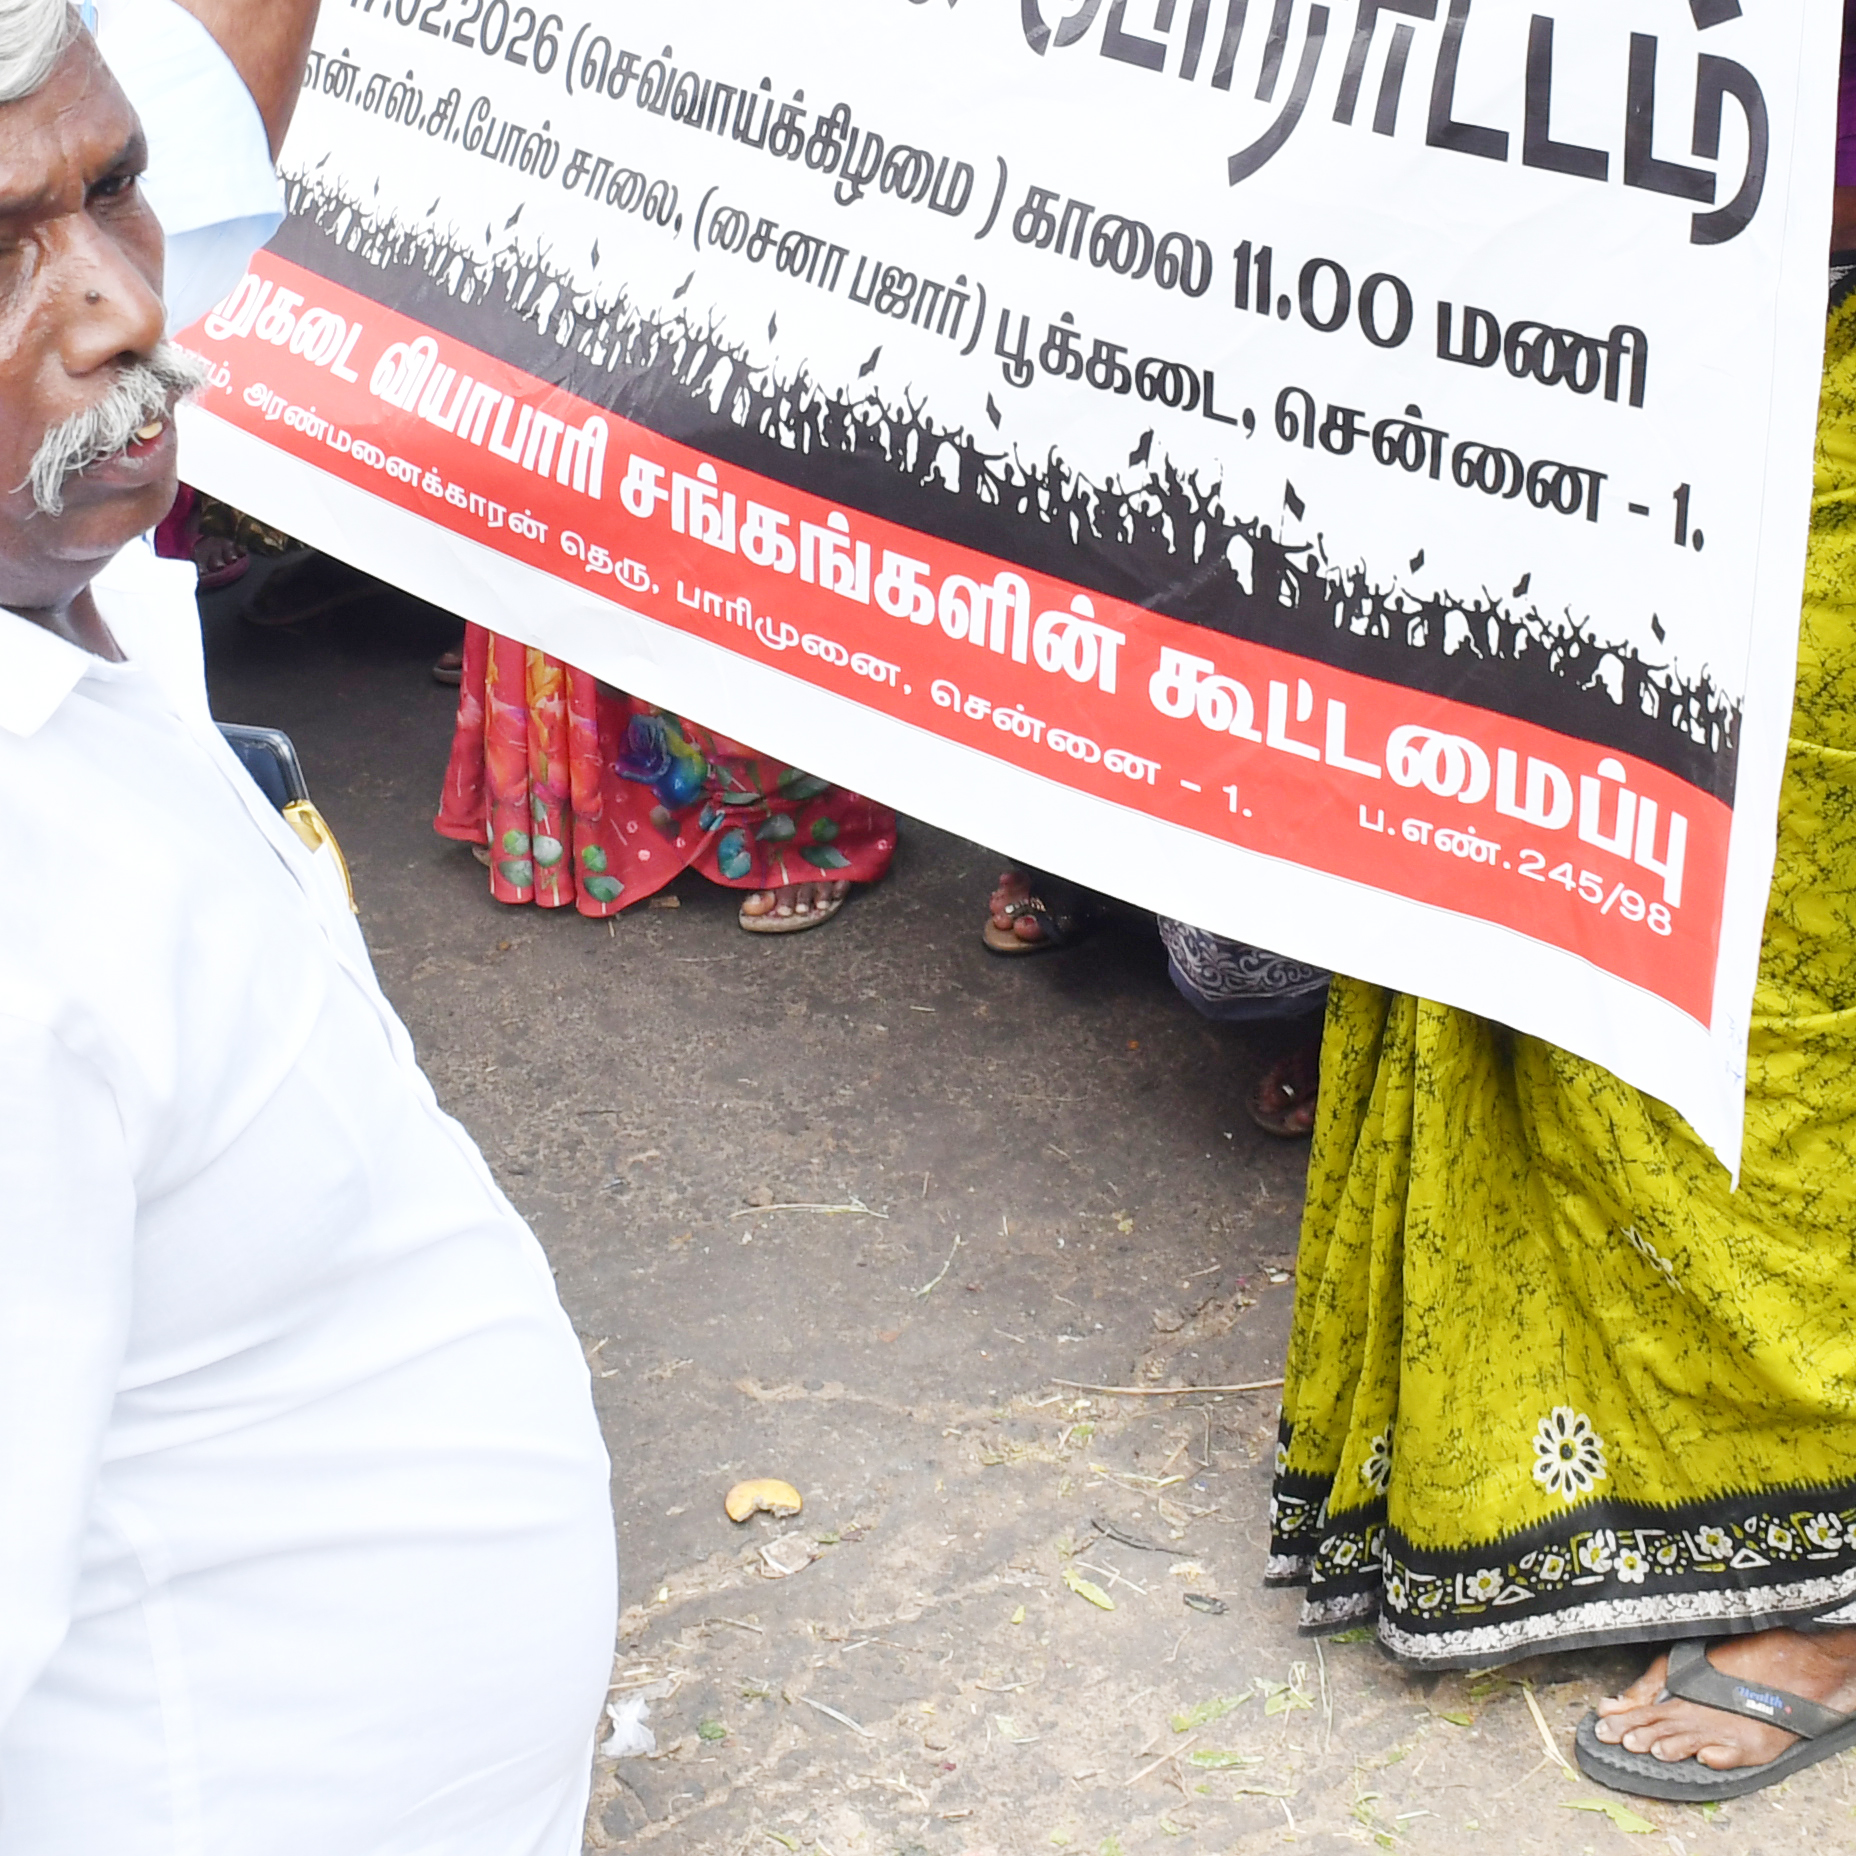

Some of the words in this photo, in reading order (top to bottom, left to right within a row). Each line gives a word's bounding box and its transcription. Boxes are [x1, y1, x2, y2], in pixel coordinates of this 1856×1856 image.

[562, 148, 685, 235] சாலை,
[689, 181, 846, 286] (சைனா
[847, 241, 986, 360] பஜார்)
[993, 304, 1258, 444] பூக்கடை,
[1274, 384, 1610, 526] சென்னை
[1013, 183, 1214, 299] காலை
[1232, 238, 1414, 350] 11.00
[1435, 297, 1649, 411] மணி
[203, 272, 361, 386] றுகடை
[369, 334, 607, 503] வியாபாரி
[618, 461, 1129, 696] சங்கங்களின்
[1147, 645, 1690, 912] கூட்டமைப்பு
[240, 377, 550, 545] அரண்மனைக்காரன்
[558, 532, 662, 599] தெரு,
[675, 580, 915, 696] பாரிமுனை,
[928, 673, 1162, 788] சென்னை
[1356, 801, 1674, 940] ப.எண்.245/98
